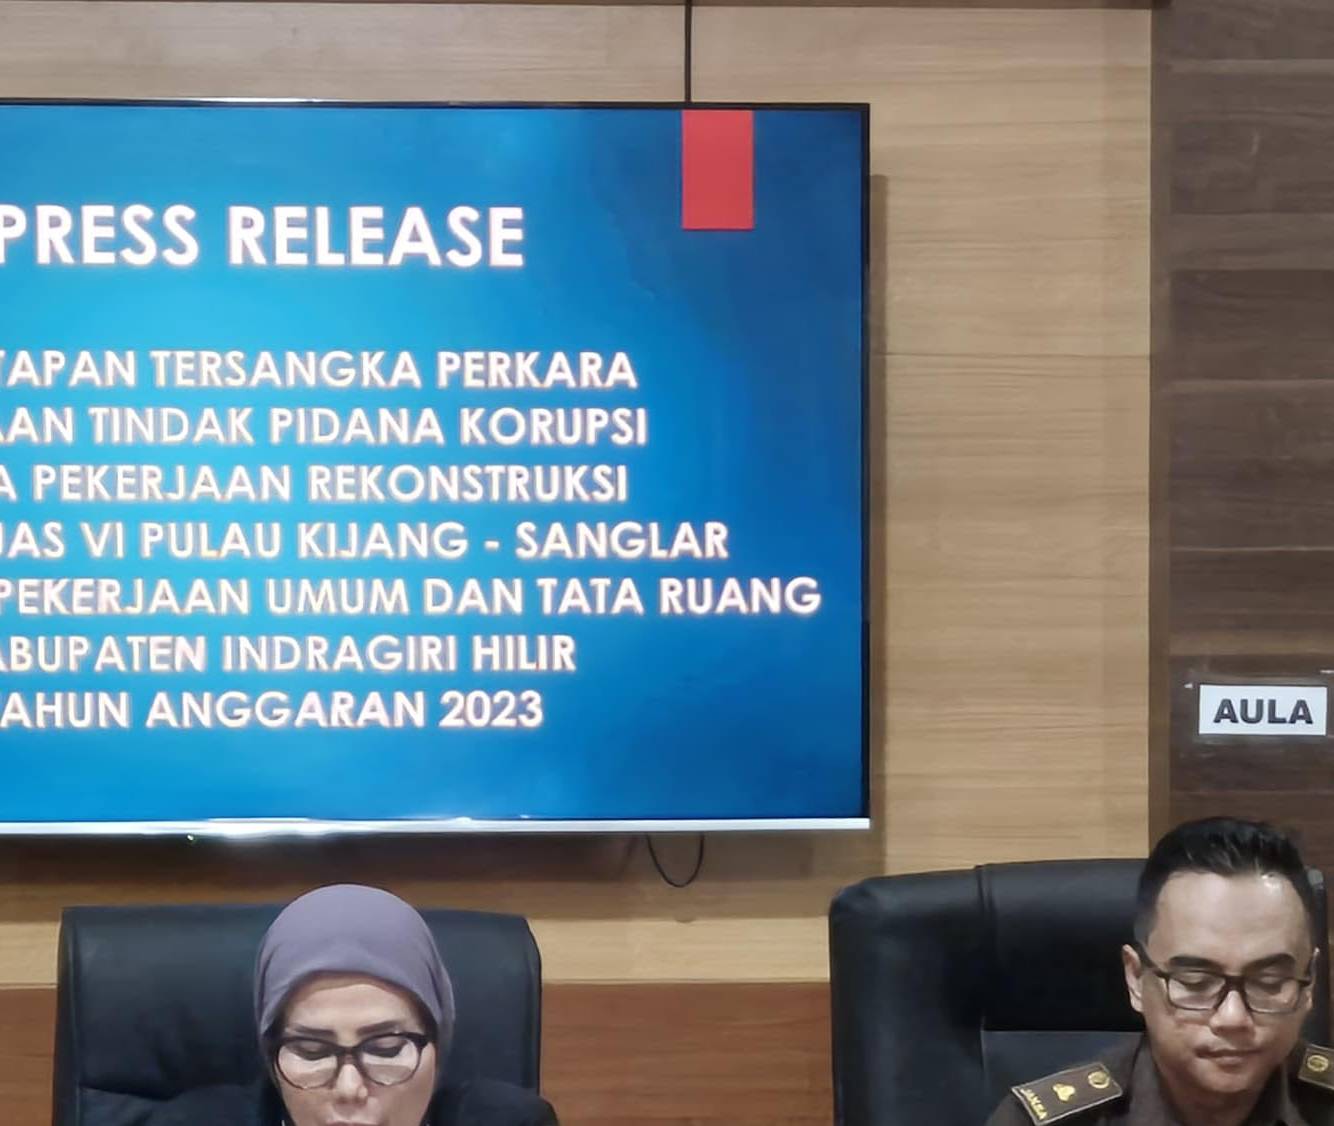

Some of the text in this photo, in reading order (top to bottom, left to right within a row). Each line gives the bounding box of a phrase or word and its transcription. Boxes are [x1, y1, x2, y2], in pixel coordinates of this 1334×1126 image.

[227, 204, 525, 269] RELEASE
[148, 349, 422, 390] TERSANGKA
[436, 350, 639, 390] PERKARA
[86, 405, 256, 446] TINDAK
[268, 406, 446, 446] PIDANA
[459, 406, 648, 447] KORUPSI
[31, 463, 293, 504] PEKERJAAN
[306, 463, 628, 504] REKONSTRUKSI
[79, 520, 126, 560] VI
[139, 520, 283, 561] PULAU
[296, 520, 470, 561] KIJANG
[514, 520, 730, 560] SANGLAR
[264, 577, 411, 617] UMUM
[422, 577, 524, 616] DAN
[535, 576, 645, 616] TATA
[659, 575, 822, 616] RUANG
[221, 633, 458, 674] INDRAGIRI
[471, 633, 577, 673] HILIR
[144, 689, 426, 730] ANGGARAN
[438, 689, 544, 729] 2023
[1212, 697, 1314, 725] AULA
